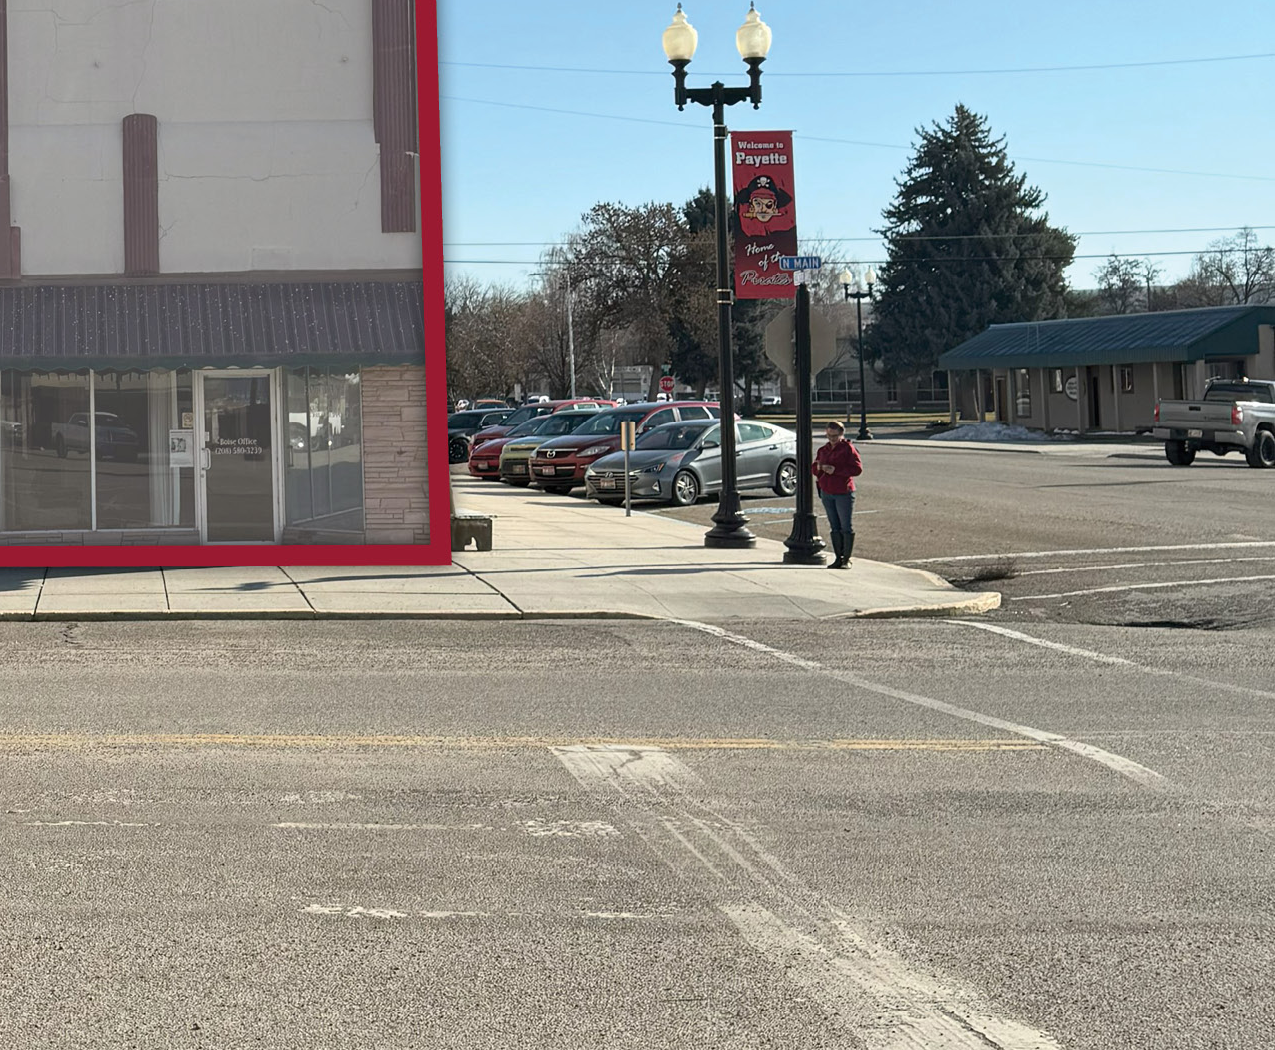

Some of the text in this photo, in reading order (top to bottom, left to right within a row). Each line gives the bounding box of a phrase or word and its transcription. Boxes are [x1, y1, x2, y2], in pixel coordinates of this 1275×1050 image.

[738, 141, 784, 149] Welcome to
[735, 152, 787, 167] Payette
[745, 242, 775, 257] Home
[758, 254, 769, 272] of
[782, 258, 819, 269] N MAIN
[237, 437, 258, 446] Office
